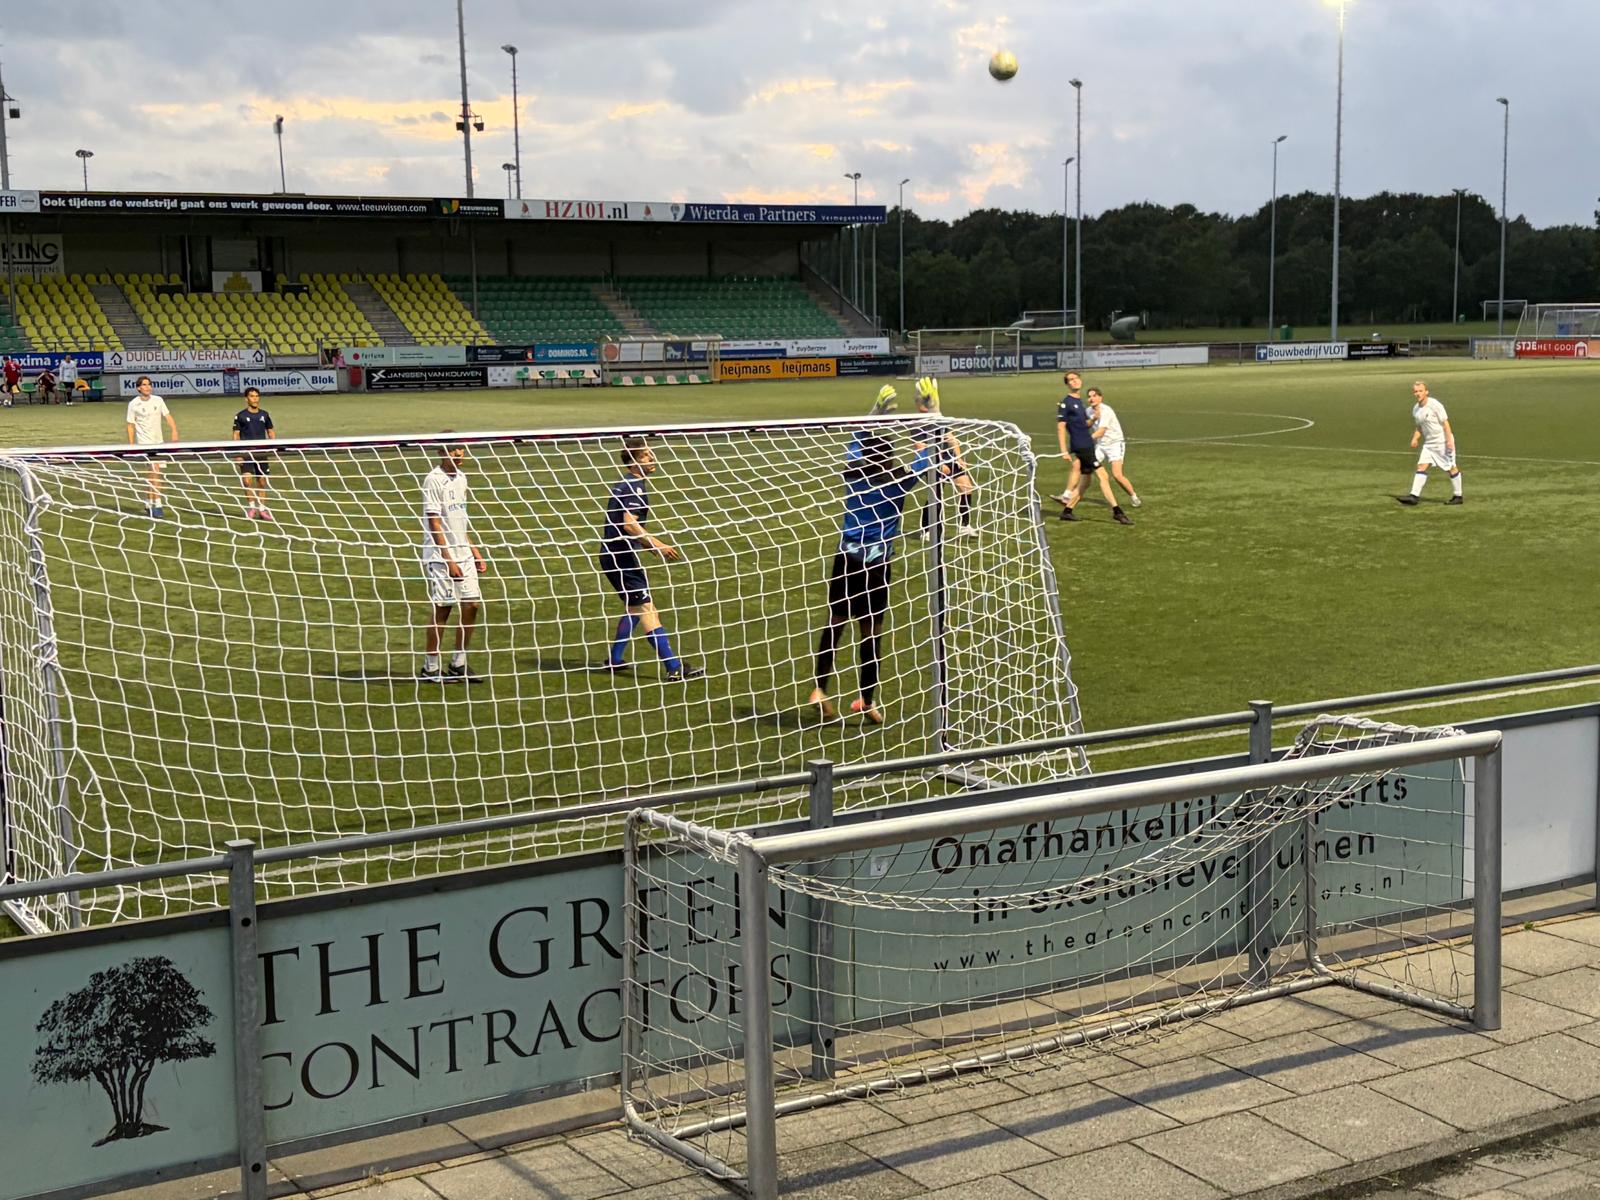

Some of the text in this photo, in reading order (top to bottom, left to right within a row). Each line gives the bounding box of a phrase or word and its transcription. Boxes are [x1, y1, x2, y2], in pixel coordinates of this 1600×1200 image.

[42, 198, 66, 207] Ook
[68, 197, 107, 209] tijdens
[109, 198, 122, 207] de
[125, 198, 177, 210] wedstrijd
[180, 200, 205, 210] gaat
[231, 200, 258, 210] werk
[262, 202, 304, 212] gewoon
[306, 201, 333, 211] door.
[336, 203, 427, 213] www.teeuwissen.com
[544, 201, 629, 220] HZ101.nl
[690, 205, 740, 221] Wierda
[743, 211, 755, 221] en
[759, 206, 817, 222] Partners
[126, 349, 245, 362] DUIDELIJK VERHAAL
[1268, 344, 1322, 358] Bouwbedrijf
[1323, 345, 1345, 355] VLOT
[0, 354, 51, 367] axima
[951, 355, 1018, 370] DEGROOT.NU
[720, 362, 772, 377] heijmans
[781, 361, 831, 375] heijmans
[124, 375, 335, 390] Knmeijer Blok Knipmeijer Blok
[971, 888, 1009, 925] in
[1275, 831, 1375, 871] uinen
[933, 869, 1406, 974] www.thegreencontacors.nl
[257, 922, 446, 1027] THE
